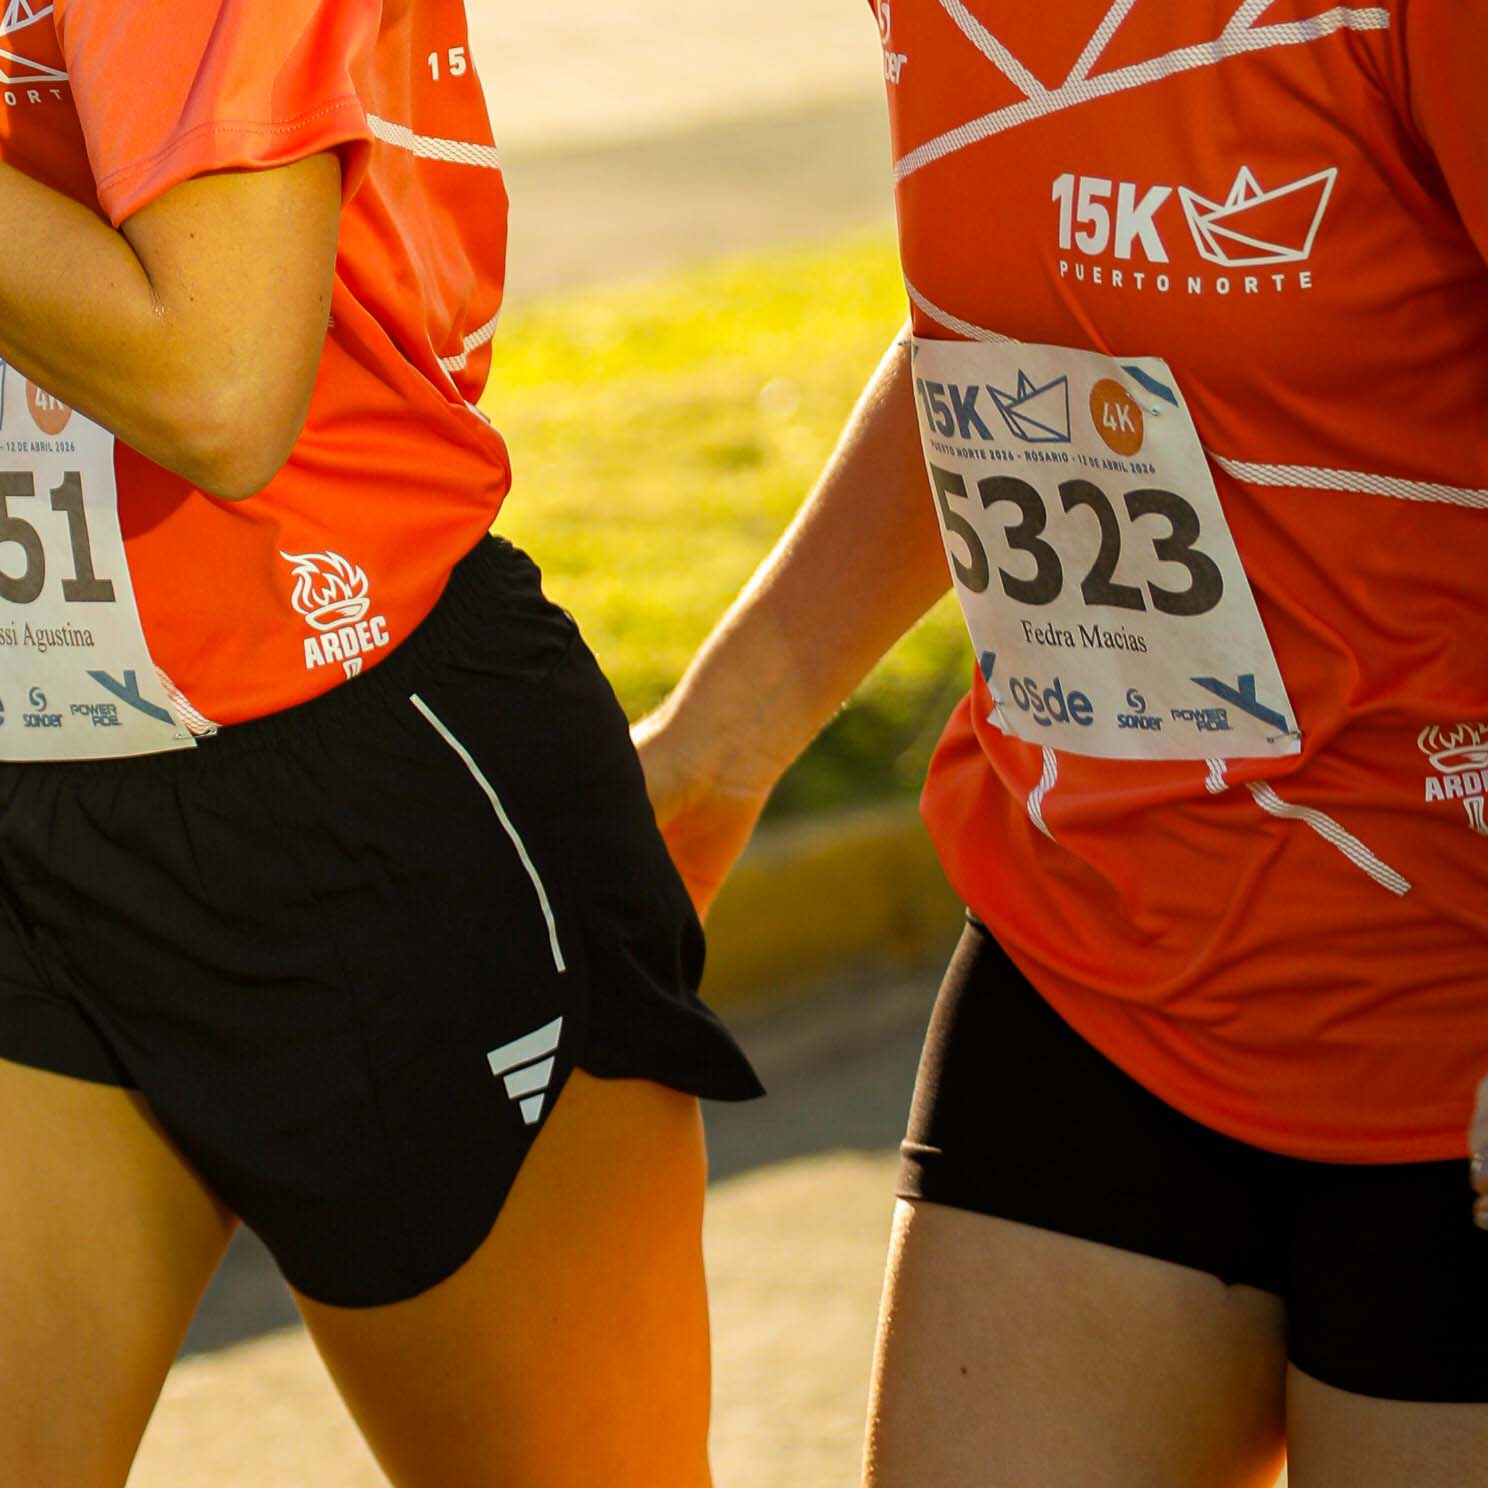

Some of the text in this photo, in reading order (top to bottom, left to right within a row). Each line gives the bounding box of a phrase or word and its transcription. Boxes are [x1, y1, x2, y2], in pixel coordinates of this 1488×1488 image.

[427, 45, 474, 81] 15
[1051, 172, 1173, 264] 15K
[1059, 259, 1312, 295] PUERTO NORTE
[916, 377, 994, 442] 15K
[1102, 401, 1137, 434] 4K
[6, 441, 16, 452] 12
[17, 441, 29, 453] DE
[30, 442, 54, 453] ABRIL
[55, 442, 76, 453] 2026
[956, 446, 987, 461] NORTE
[989, 449, 1014, 462] 2026
[1024, 449, 1069, 464] ROSARIO
[1102, 459, 1129, 474] ABRIL
[1130, 462, 1157, 475] 2026
[928, 461, 1224, 617] 5323
[23, 622, 95, 653] Agustina
[303, 615, 390, 671] ARDEC
[1020, 619, 1148, 653] Fedra Macias
[1008, 676, 1095, 728] osde
